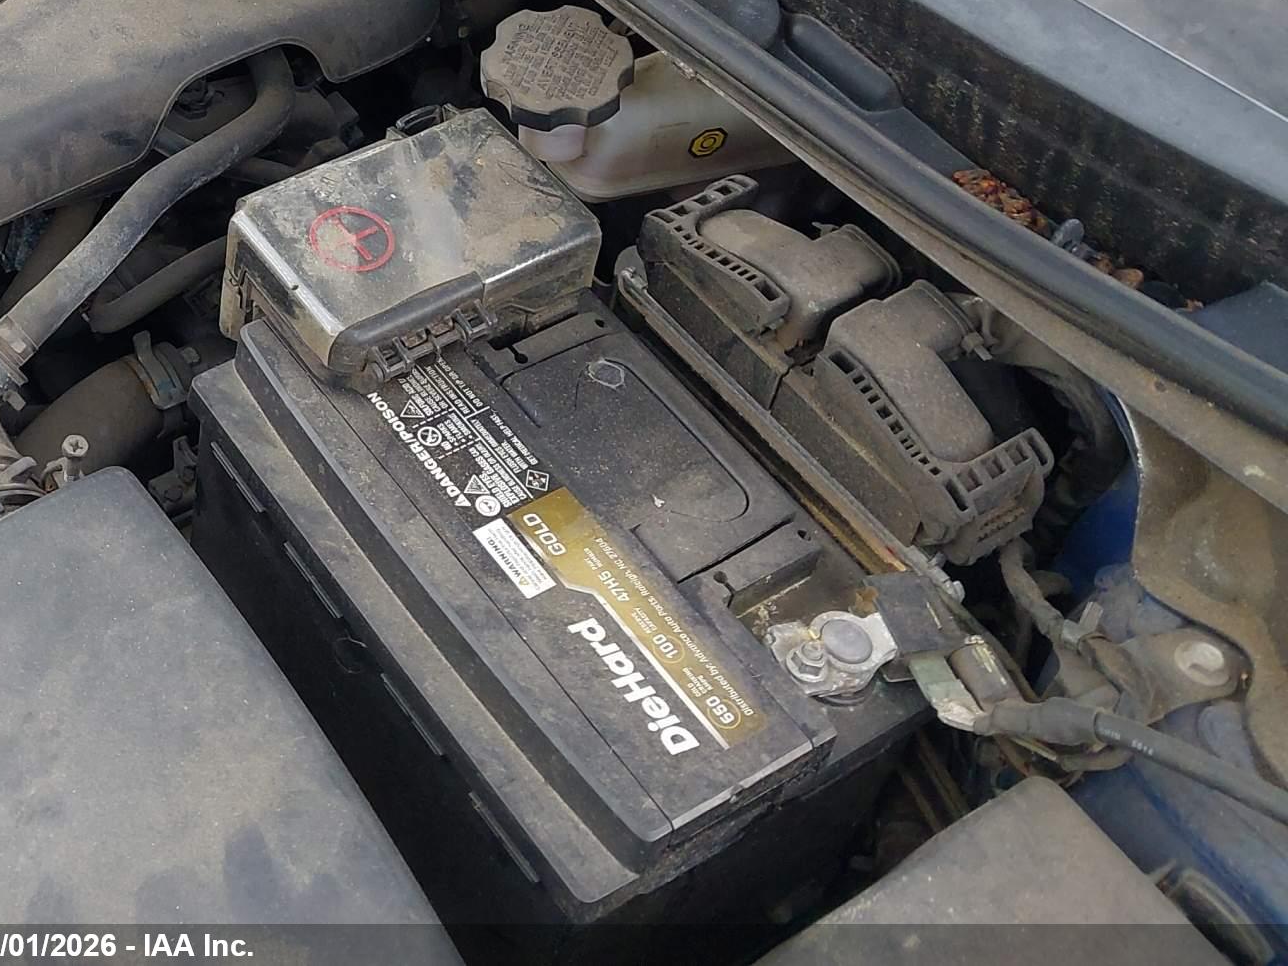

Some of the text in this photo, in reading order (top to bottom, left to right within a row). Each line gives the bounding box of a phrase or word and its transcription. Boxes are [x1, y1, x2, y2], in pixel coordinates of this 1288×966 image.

[366, 391, 460, 497] DANGER/POISON
[521, 510, 567, 557] GOLD
[651, 631, 679, 659] 100
[664, 615, 682, 633] Auto
[566, 617, 700, 754] DieHard
[714, 674, 754, 716] Distributed
